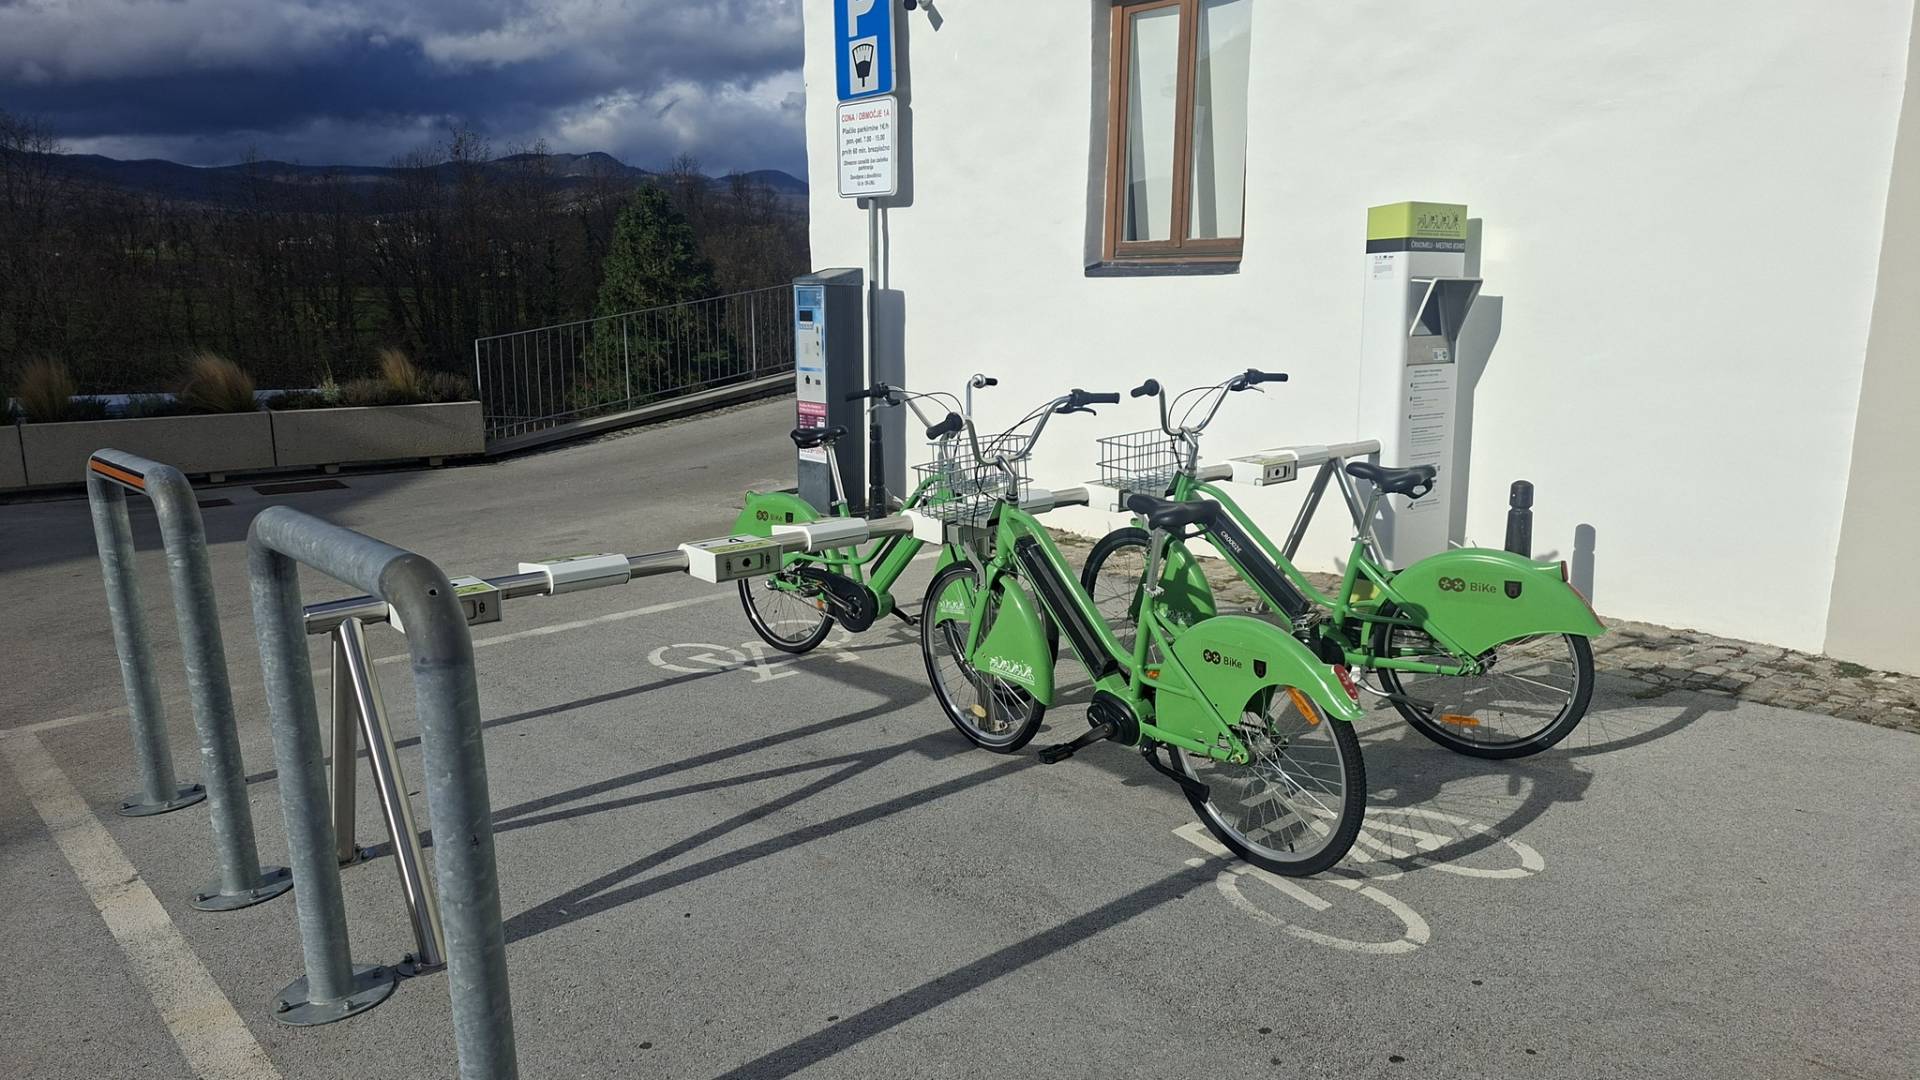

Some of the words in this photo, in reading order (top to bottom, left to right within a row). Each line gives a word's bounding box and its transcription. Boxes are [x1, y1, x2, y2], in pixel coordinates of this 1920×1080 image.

[848, 0, 875, 37] P
[1469, 582, 1497, 594] BiKe
[1223, 657, 1243, 669] BiKe
